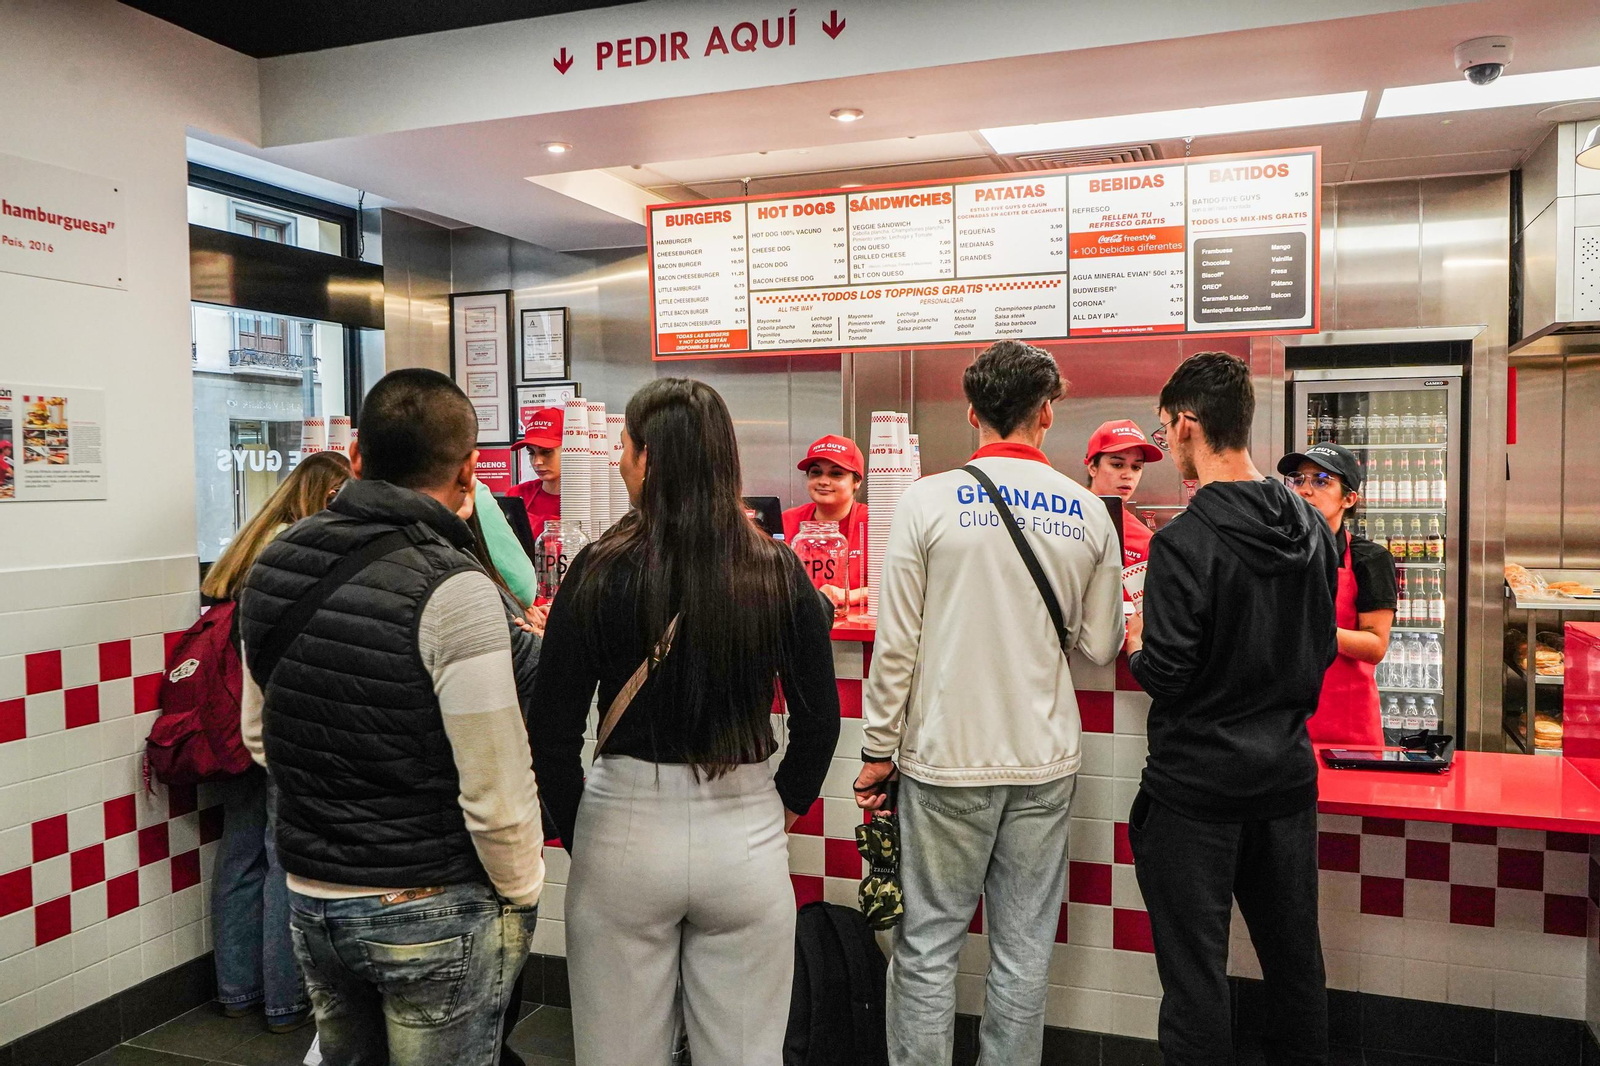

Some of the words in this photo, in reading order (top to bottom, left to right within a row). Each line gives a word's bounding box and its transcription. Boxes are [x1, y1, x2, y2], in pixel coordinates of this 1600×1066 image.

[596, 31, 690, 70] PEDIR
[704, 9, 797, 56] AQUÍ
[1209, 163, 1289, 183] BATIDOS
[1089, 174, 1164, 192] BEBIDAS
[975, 184, 1045, 202] PATATAS
[1192, 197, 1220, 205] BATIDO
[758, 206, 788, 219] HOT
[793, 202, 835, 216] DOGS
[850, 192, 952, 212] SÁNDWICHES
[666, 210, 731, 227] BURGERS
[1089, 220, 1132, 228] REFRESCO
[29, 240, 53, 252] 2016
[1100, 245, 1134, 253] bebidas
[1137, 243, 1182, 251] diferentes
[822, 290, 858, 301] TODOS
[860, 290, 881, 300] LOS
[885, 286, 939, 298] TOPPINGS
[942, 284, 983, 295] GRATIS
[960, 511, 999, 528] Club
[1033, 516, 1084, 541] Fútbol
